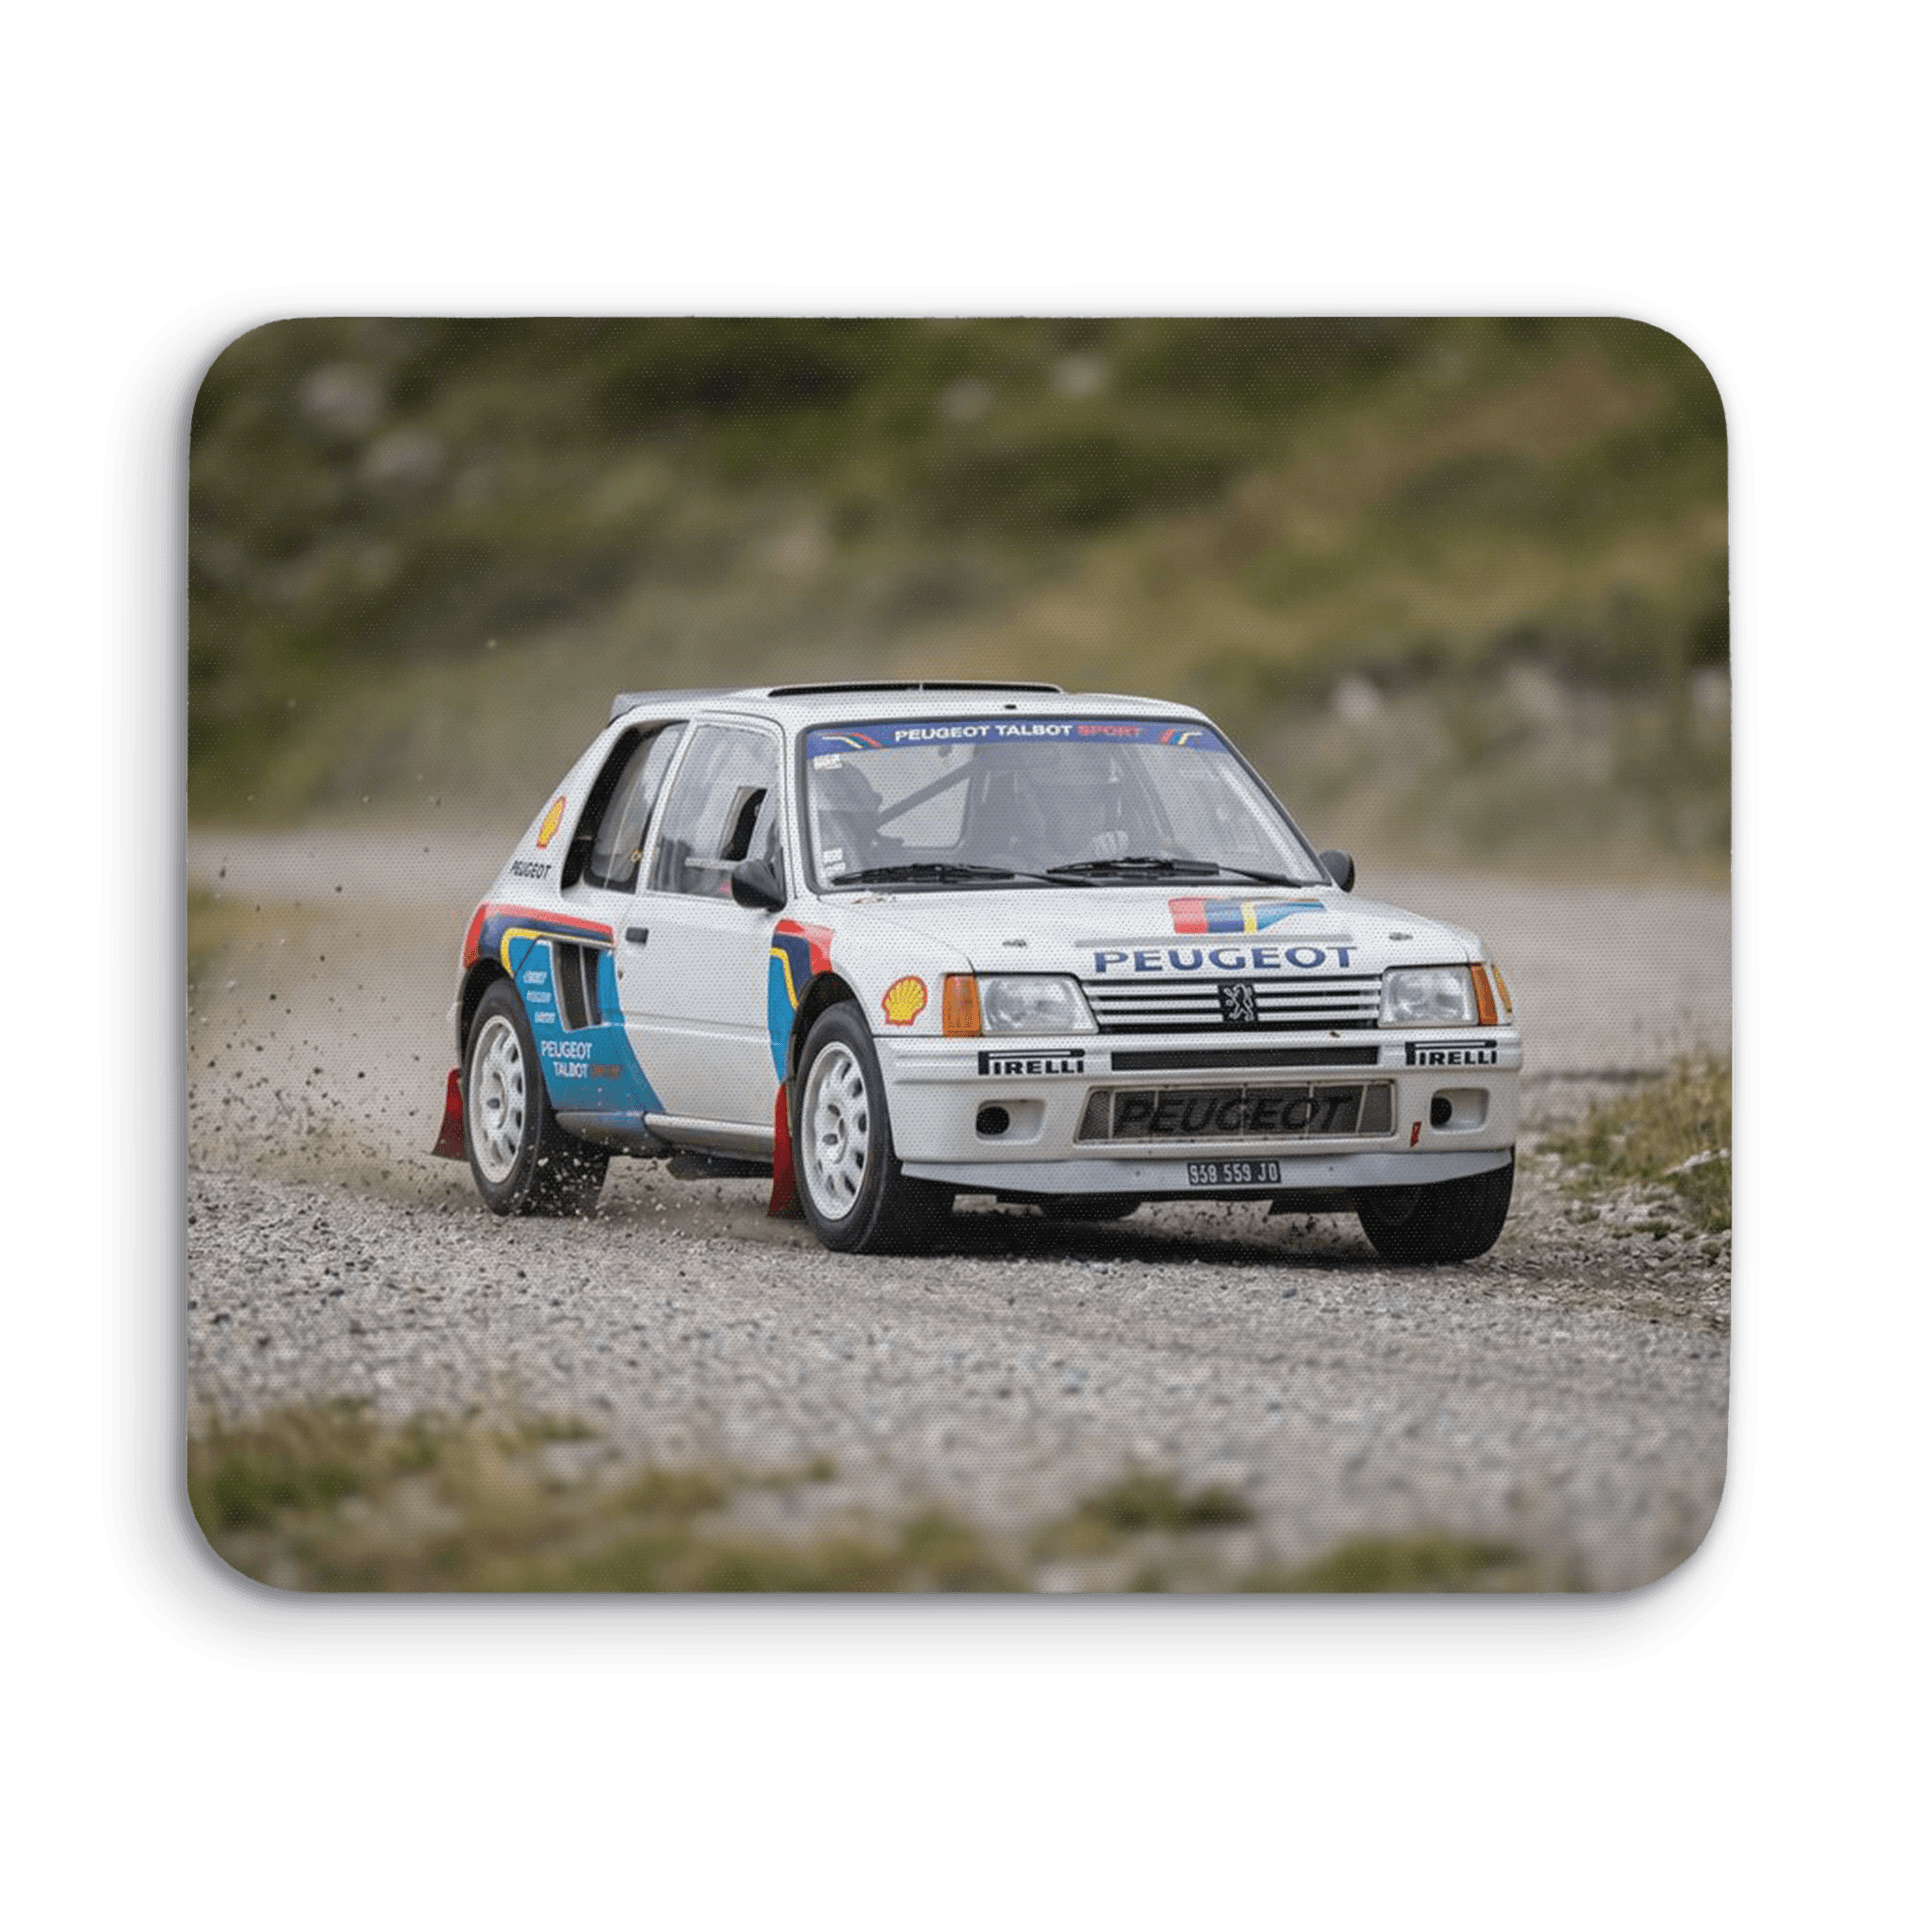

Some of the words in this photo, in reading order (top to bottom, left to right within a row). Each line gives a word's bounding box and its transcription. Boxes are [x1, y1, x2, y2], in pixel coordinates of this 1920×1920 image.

[894, 725, 990, 742] PEUGEOT
[995, 724, 1073, 736] TALBOT
[1094, 946, 1357, 973] PEUGEOT
[541, 1040, 593, 1060] PEUGEOT
[978, 1048, 1086, 1075] PIRELLI
[1405, 1039, 1497, 1065] PIRELLI
[553, 1061, 588, 1079] TALBOT
[1114, 1096, 1353, 1133] PEUGEOT
